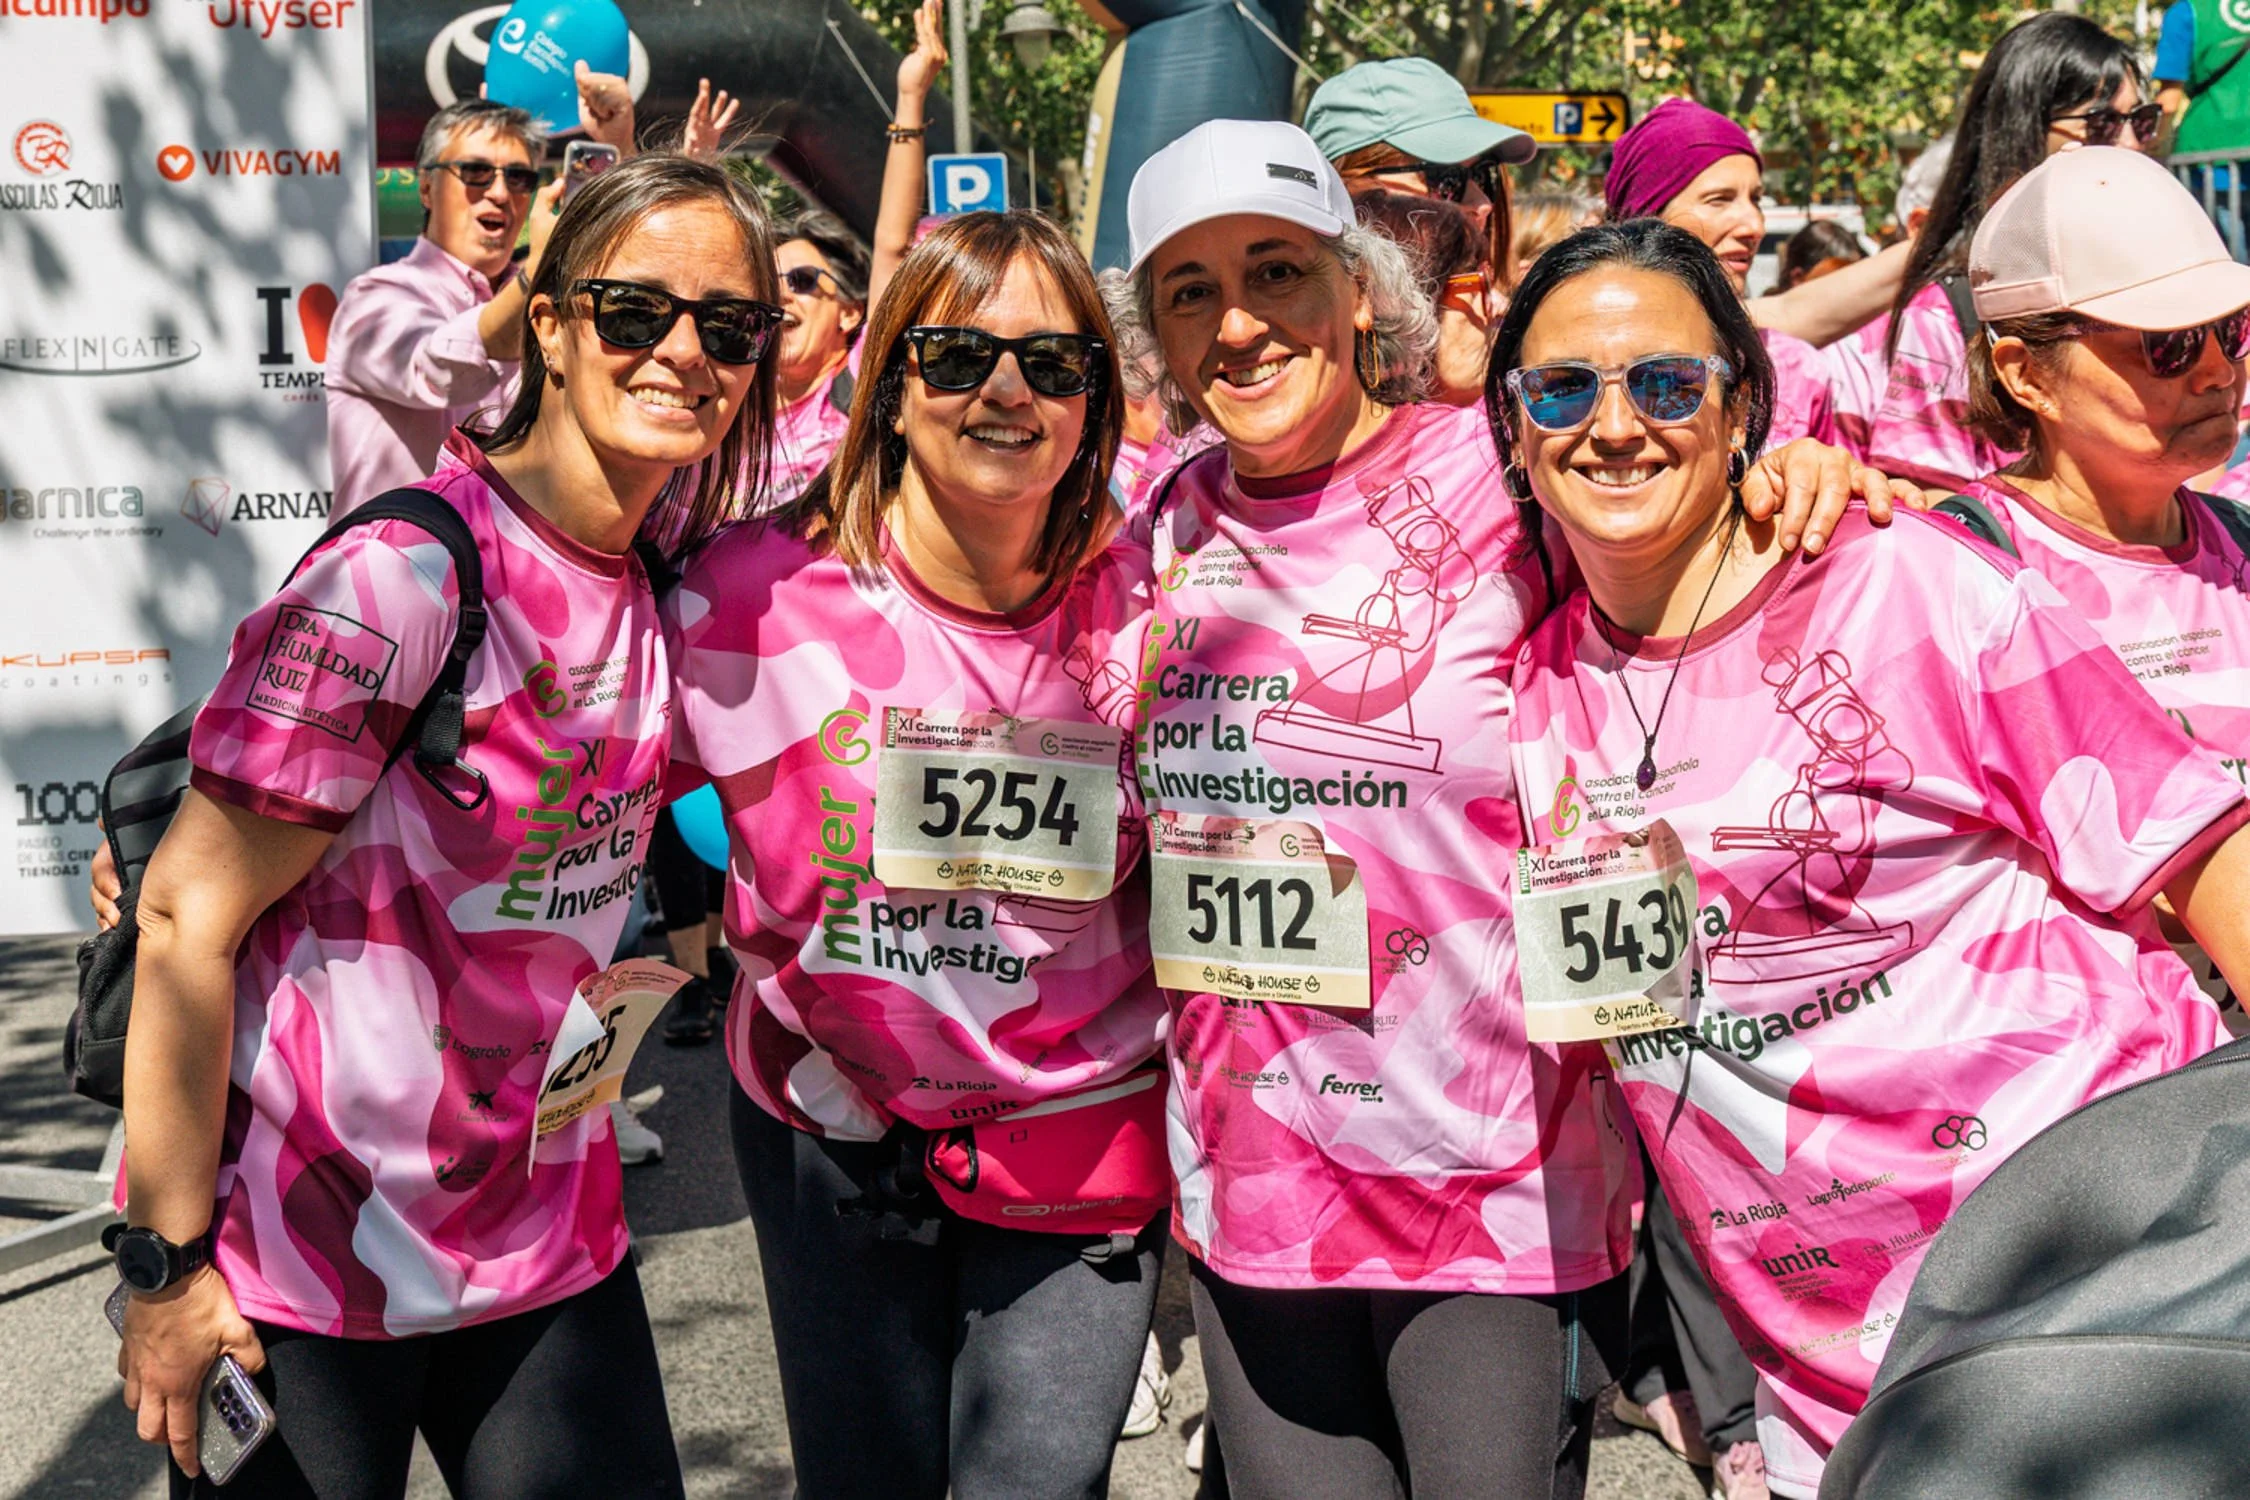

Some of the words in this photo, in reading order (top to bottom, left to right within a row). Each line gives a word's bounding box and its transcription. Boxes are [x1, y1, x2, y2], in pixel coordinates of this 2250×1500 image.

[1556, 103, 1579, 134] P
[202, 150, 341, 176] VIVAGYM
[945, 164, 991, 212] P
[1167, 617, 1200, 651] XI
[2126, 653, 2163, 667] contra
[2146, 668, 2162, 679] La
[2163, 662, 2191, 676] Rioja
[262, 662, 309, 692] RUIZ
[1158, 664, 1290, 702] Carrera
[899, 718, 913, 732] XI
[916, 722, 959, 735] Carrera
[962, 726, 979, 738] por
[981, 726, 992, 736] la
[1154, 719, 1203, 758] por
[1212, 714, 1247, 752] la
[577, 739, 606, 777] XI
[1155, 763, 1408, 814] Investigación
[1624, 789, 1635, 801] el
[918, 767, 1079, 846] 5254
[1614, 803, 1646, 818] Rioja
[495, 737, 578, 922] mujer
[1162, 823, 1173, 836] XI
[1174, 828, 1204, 838] Carrera
[1206, 831, 1222, 841] por
[1223, 830, 1232, 840] la
[553, 837, 604, 881] por
[610, 824, 636, 860] la
[1530, 858, 1545, 873] XI
[1548, 855, 1586, 870] Carrera
[1588, 852, 1607, 865] por
[1609, 849, 1621, 860] la
[19, 865, 80, 878] TIENDAS
[811, 786, 870, 965] mujer
[997, 865, 1045, 882] HOUSE
[870, 901, 936, 933] por
[945, 898, 983, 930] la
[1187, 873, 1317, 951] 5112
[1560, 883, 1688, 983] 5439
[1258, 975, 1302, 991] HOUSE
[1614, 1002, 1657, 1021] NATUR
[452, 1038, 511, 1059] Logroño
[936, 1080, 953, 1091] La
[957, 1080, 997, 1092] Rioja
[1319, 1074, 1382, 1096] Ferrer
[1729, 1210, 1748, 1226] La
[1747, 1201, 1789, 1222] Rioja
